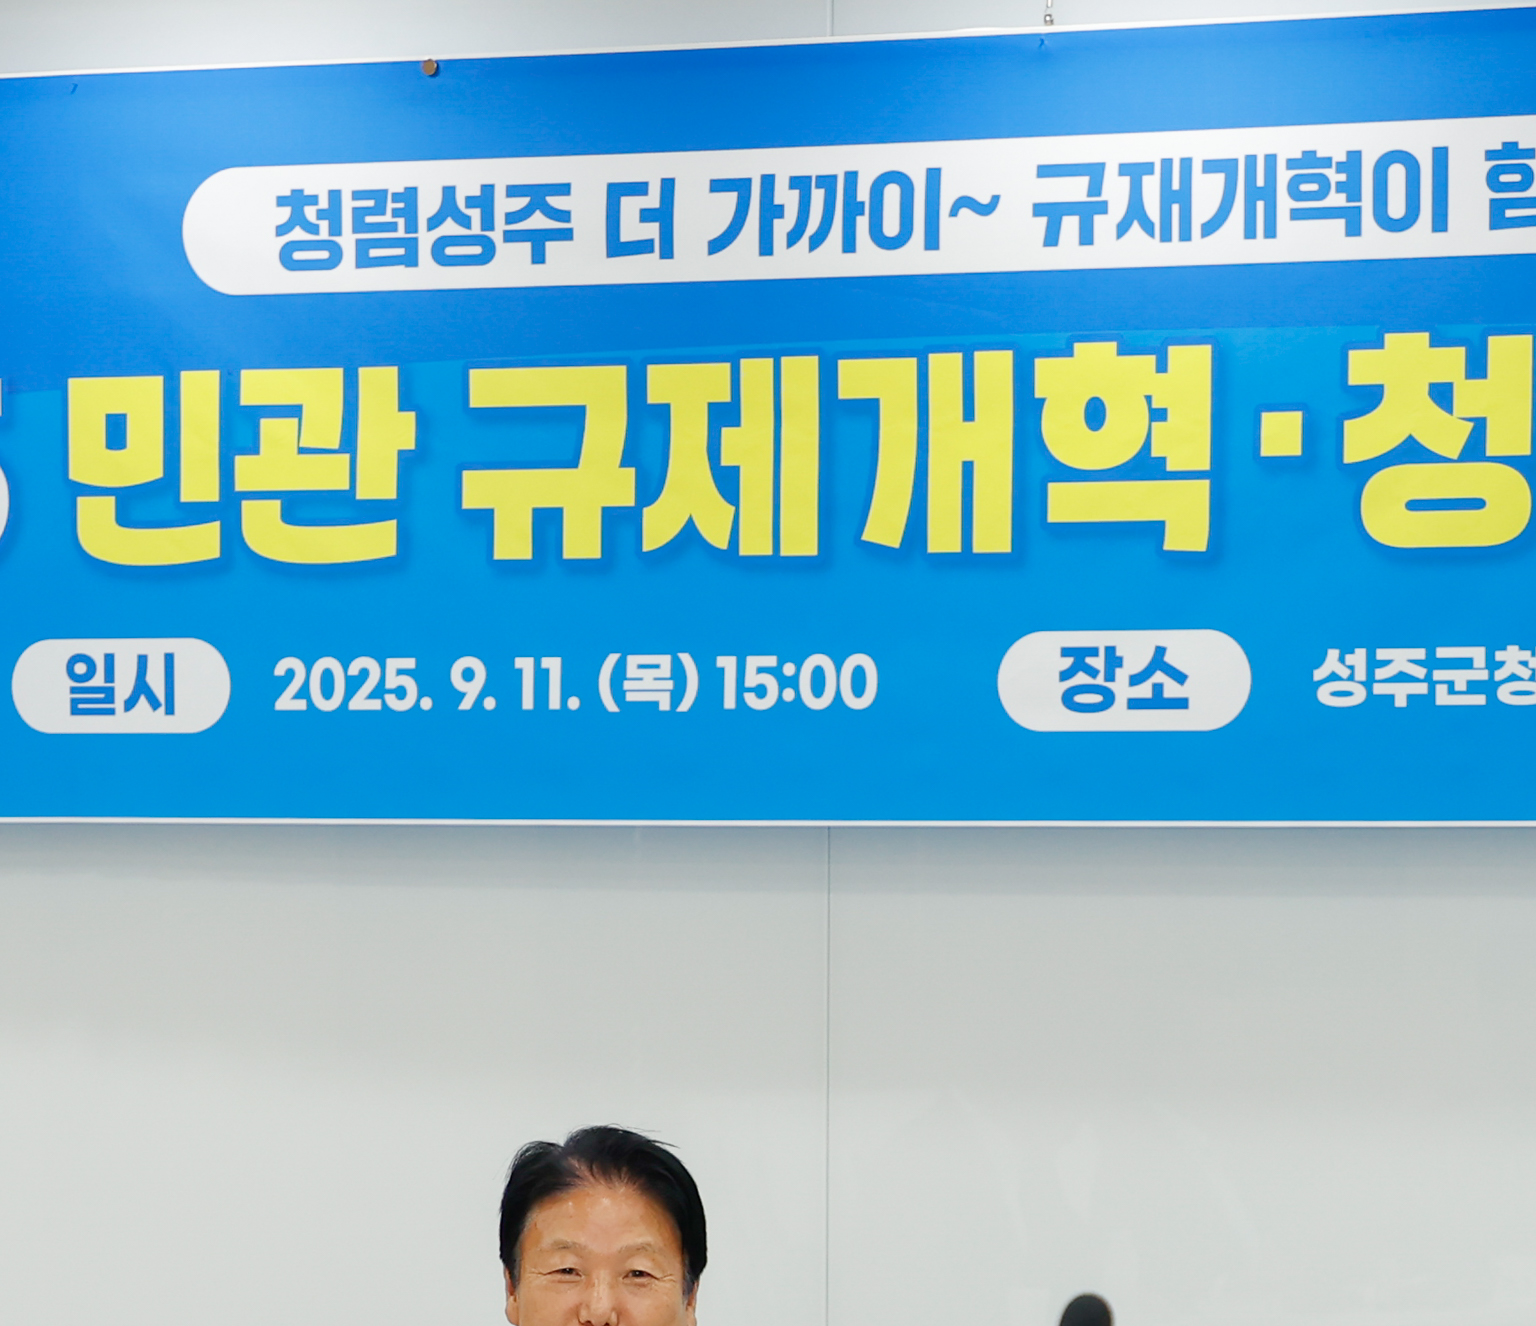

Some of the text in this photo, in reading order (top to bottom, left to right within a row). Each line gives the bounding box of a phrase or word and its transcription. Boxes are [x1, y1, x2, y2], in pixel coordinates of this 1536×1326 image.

[275, 182, 573, 272] 청렴성주
[606, 177, 676, 260] 더
[707, 166, 1001, 257] 가까이~
[1032, 146, 1451, 249] 규재개혁이
[66, 365, 416, 567] 민관
[65, 651, 879, 717] 일시 2025. 9. 11. (목) 15:00
[1058, 645, 1190, 713] 장소
